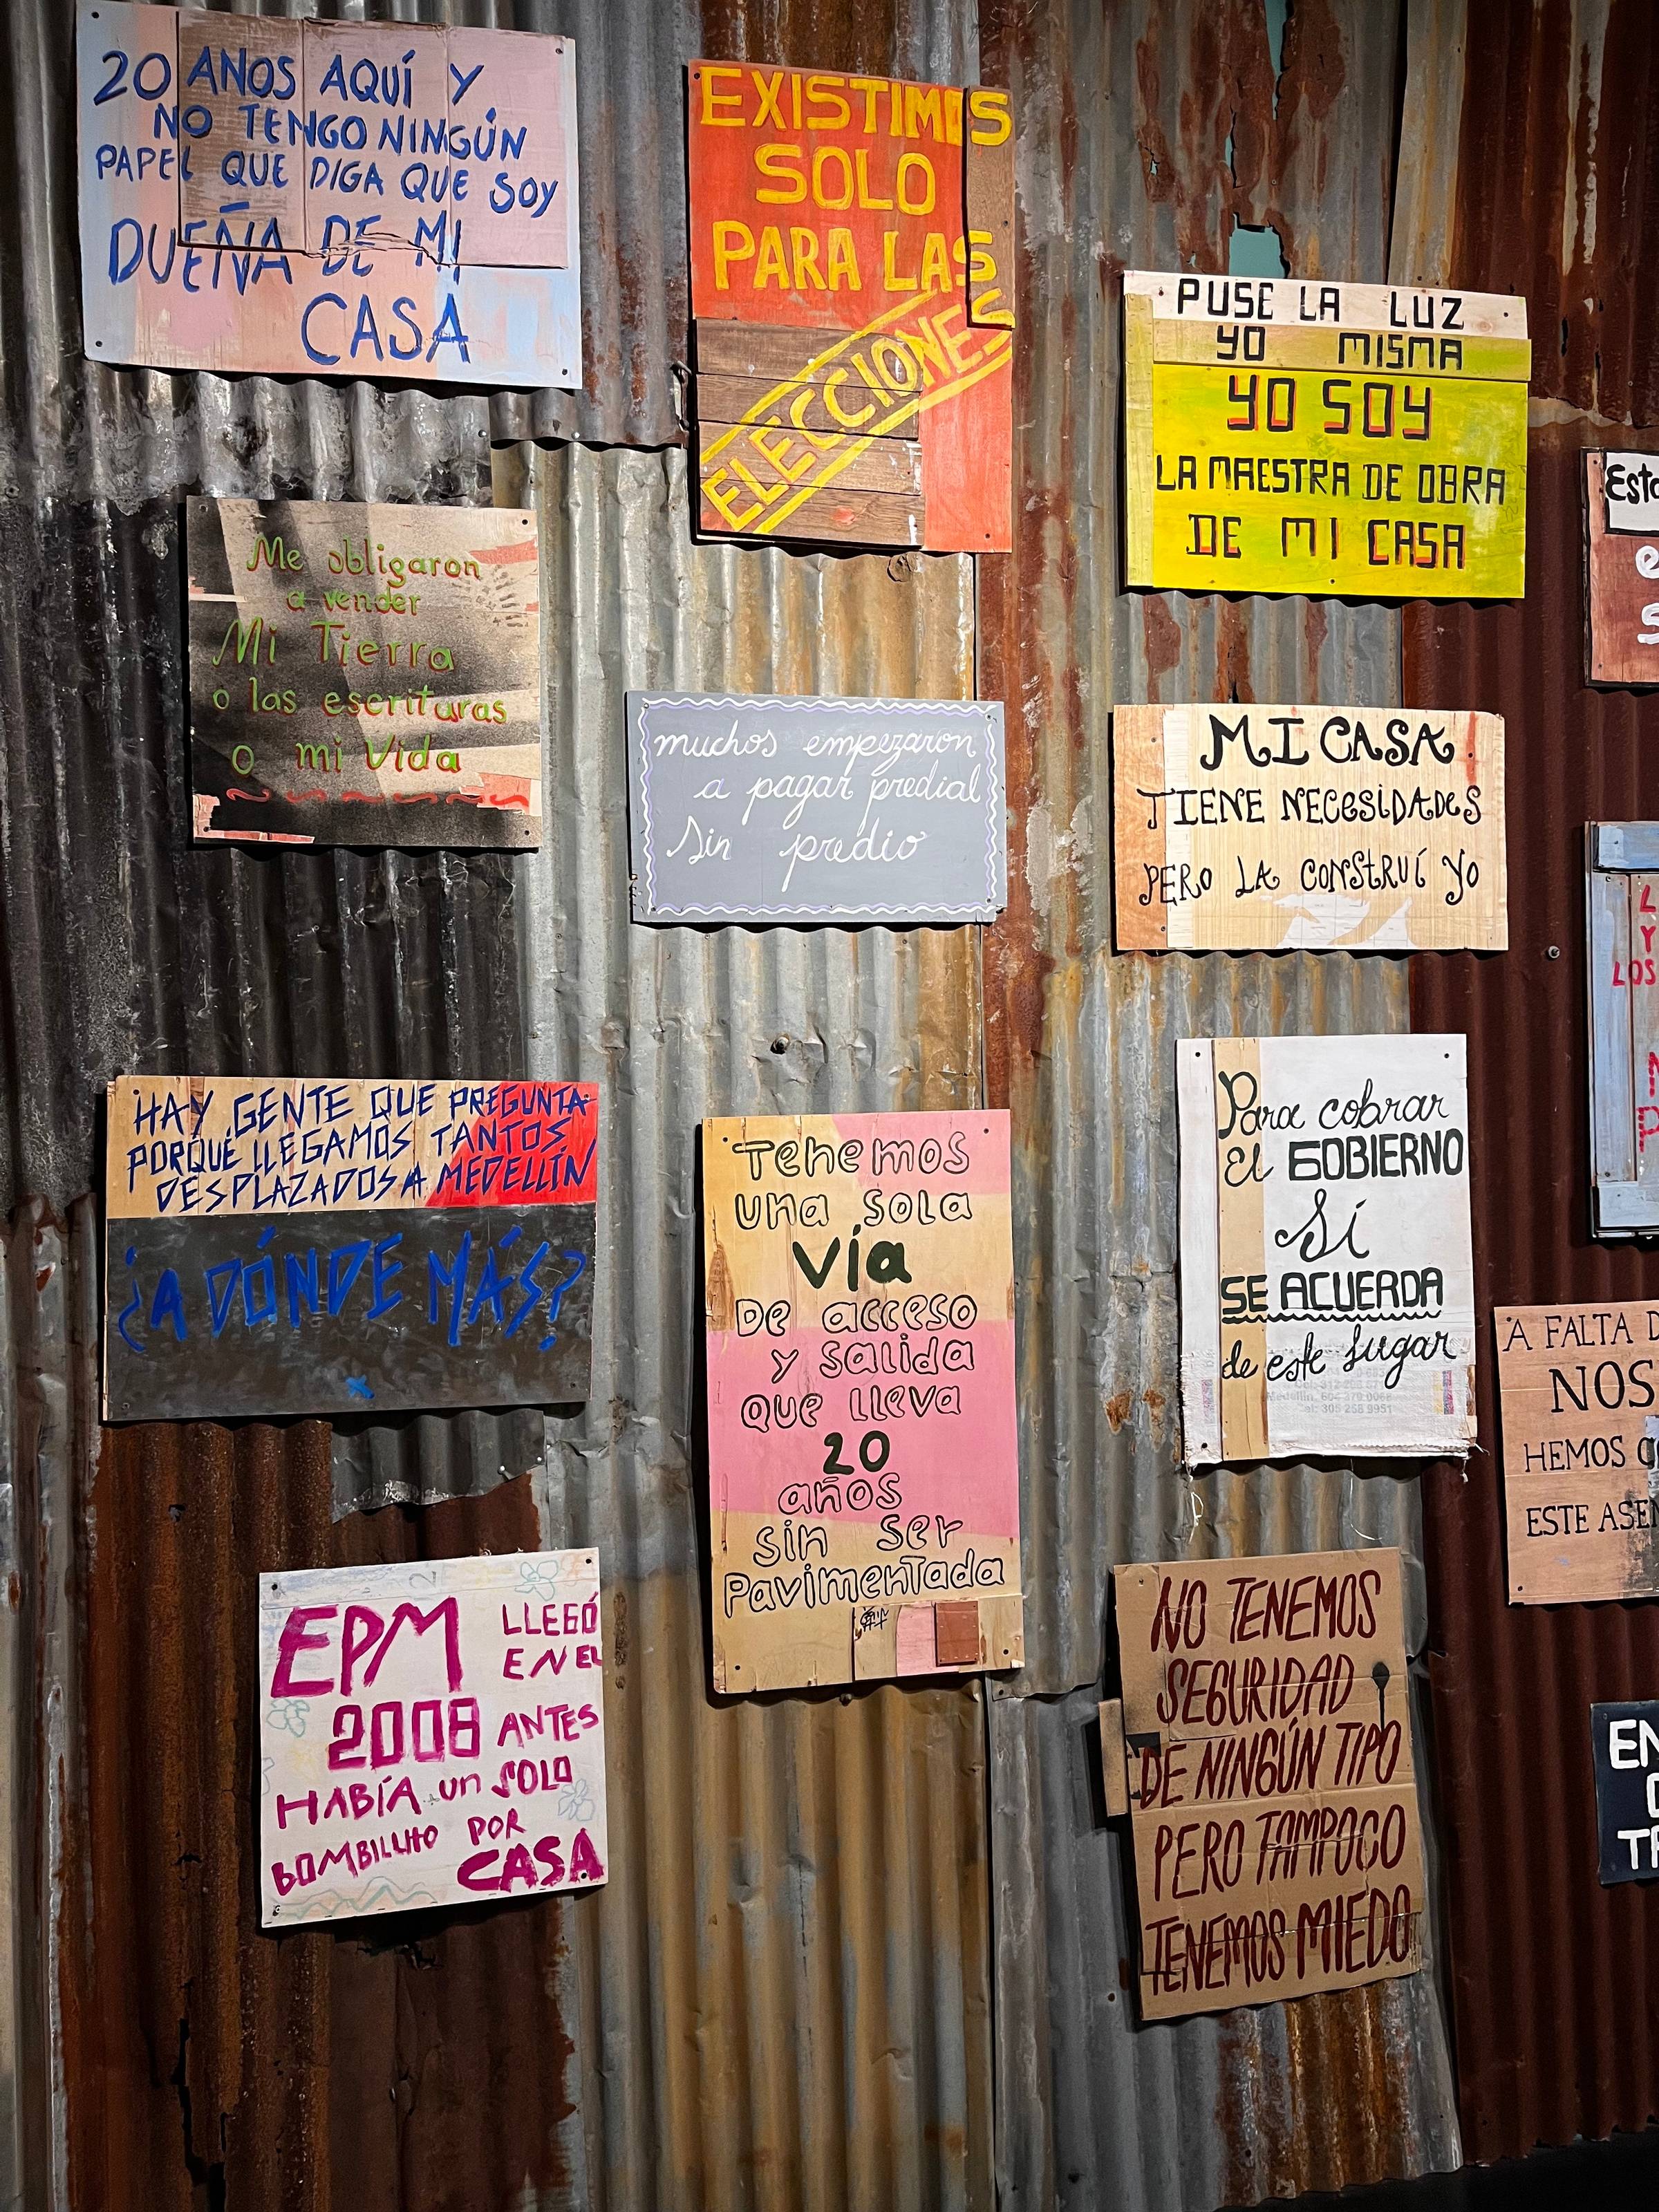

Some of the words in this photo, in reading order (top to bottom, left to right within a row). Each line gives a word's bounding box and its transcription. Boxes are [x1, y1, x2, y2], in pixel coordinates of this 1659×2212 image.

[94, 50, 173, 105] 20
[320, 50, 415, 107] AQUÍ
[451, 64, 484, 106] Y
[154, 103, 212, 139] NO
[241, 103, 366, 150] TENGO
[378, 107, 526, 161] NINGÚN
[95, 144, 194, 182] PAPEL
[222, 151, 289, 189] QUE
[310, 156, 384, 196] DIGA
[401, 162, 469, 203] QUE
[490, 173, 559, 217] SOY
[755, 143, 935, 216] SOLO
[109, 201, 293, 296] DUEÑA
[322, 215, 382, 276] DE
[415, 210, 462, 285] MI
[713, 221, 861, 291] PARA
[884, 230, 997, 292] LAS
[301, 293, 471, 364] CASA
[1177, 279, 1273, 320] PUSE
[1300, 285, 1340, 321] LA
[1389, 291, 1464, 330] LUZ
[1217, 326, 1266, 361] YO
[1338, 332, 1463, 371] MISMA
[700, 287, 1015, 532] ELECCIONES
[1227, 375, 1296, 432] YO
[1322, 379, 1432, 440] SOY
[1156, 454, 1197, 491] LA
[1209, 456, 1350, 497] MAESTRA
[1362, 464, 1403, 501] DE
[1418, 464, 1506, 505] OBRA
[246, 534, 304, 572] Me
[328, 537, 480, 588] obligaron
[1186, 514, 1241, 559] DE
[1282, 517, 1340, 560] MI
[1367, 519, 1466, 570] CASA
[286, 591, 306, 612] a
[323, 586, 421, 616] vender
[212, 616, 278, 668] Mi
[310, 619, 455, 673] Tierra
[249, 677, 297, 715] las
[322, 684, 508, 724] escrituras
[296, 735, 344, 773] mi
[653, 720, 778, 758] muchos
[803, 730, 976, 777] empezaron
[1200, 714, 1309, 771] MI
[1320, 715, 1456, 767] CASA
[693, 778, 731, 800] a
[741, 773, 854, 830] pagar
[856, 760, 982, 837] predial
[1136, 787, 1265, 830] TIENE
[779, 816, 930, 893] predio
[1138, 862, 1212, 906] PERO
[1235, 855, 1281, 898] LA
[133, 1089, 214, 1138] HAY
[232, 1083, 354, 1134] GENTE
[371, 1083, 438, 1125] QUE
[449, 1085, 593, 1119] PREGUNTA
[1217, 1070, 1306, 1141] Para
[1318, 1077, 1450, 1131] cobrar
[126, 1126, 244, 1193] PORQUÉ
[253, 1119, 415, 1171] LLEGAMOS
[431, 1116, 573, 1157] TANTOS
[156, 1165, 397, 1214] DESPLAZADOS
[402, 1167, 429, 1199] A
[436, 1138, 597, 1194] MEDELLÍN
[732, 1130, 970, 1181] Tenemos
[1288, 1127, 1463, 1181] GOBIERNO
[205, 1225, 404, 1339] DÓNDE
[429, 1224, 587, 1353] MÁS?
[821, 1293, 979, 1335] acceso
[1220, 1273, 1268, 1315] SE
[1280, 1266, 1443, 1311] ACUERDA
[1221, 1338, 1259, 1380] de
[1266, 1331, 1326, 1382] este
[1502, 1319, 1533, 1352] A
[1545, 1312, 1633, 1349] FALTA
[1548, 1359, 1655, 1413] NOS
[823, 1430, 890, 1476] 20
[1524, 1435, 1625, 1472] HEMOS
[778, 1471, 903, 1516] años
[1526, 1504, 1589, 1537] ESTE
[877, 1513, 964, 1552] ser
[1151, 1576, 1206, 1653] NO
[1227, 1570, 1382, 1644] TENEMOS
[270, 1595, 462, 1698] EPM
[502, 1591, 599, 1636] LLEGÓ
[503, 1645, 567, 1680] EN
[1157, 1653, 1355, 1727] SEGURIDAD
[328, 1697, 480, 1771] 2008
[497, 1704, 599, 1747] ANTES
[1140, 1743, 1187, 1809] DE
[1195, 1717, 1325, 1800] NINGÚN
[1334, 1720, 1402, 1785] TIPO
[276, 1775, 422, 1829] HABÍA
[491, 1756, 572, 1798] SOLO
[467, 1808, 528, 1846] POR
[1154, 1819, 1245, 1901] PERO
[1255, 1803, 1406, 1886] TAMPOCO
[457, 1828, 605, 1893] CASA
[1145, 1909, 1286, 1996] TENEMOS
[1297, 1884, 1412, 1979] MIEDO
